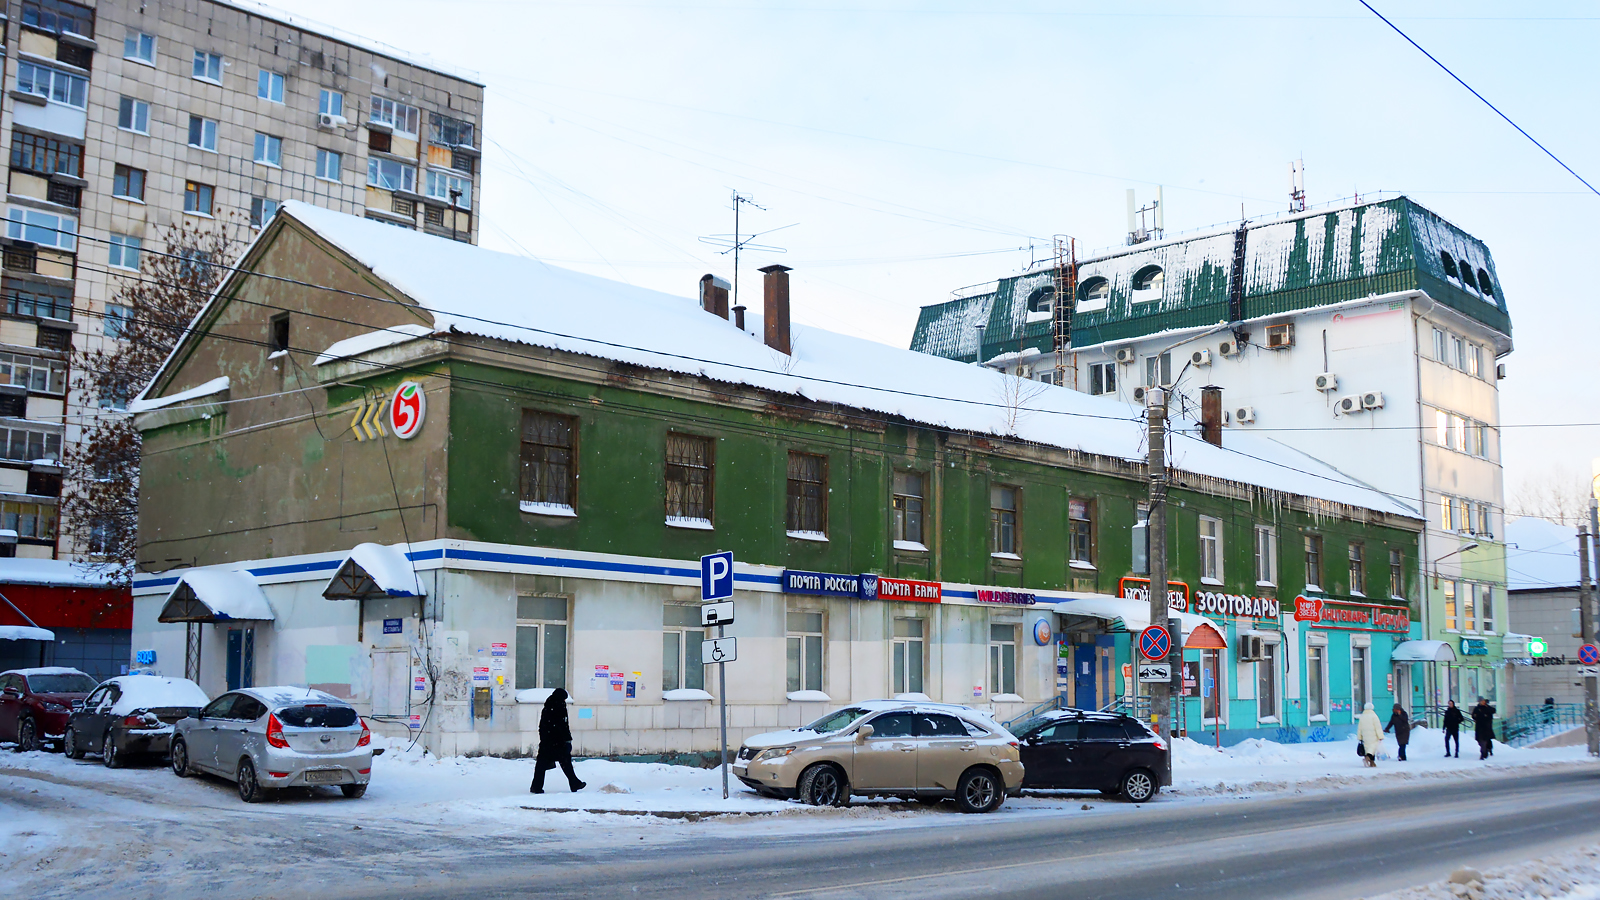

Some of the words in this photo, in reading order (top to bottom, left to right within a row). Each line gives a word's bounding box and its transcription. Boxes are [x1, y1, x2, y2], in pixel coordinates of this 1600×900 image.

[398, 400, 416, 433] 5
[709, 556, 729, 596] P
[789, 574, 821, 590] ПОЧТА
[824, 576, 858, 592] РОССИИ
[881, 580, 911, 597] ПОЧТА
[914, 583, 939, 599] БАНК
[977, 589, 1037, 605] WILDBERRIES
[1197, 590, 1280, 618] ЗООТОВАРЫ
[1321, 608, 1370, 623] АНЦТОВАРЫ
[136, 650, 154, 665] ВОДА
